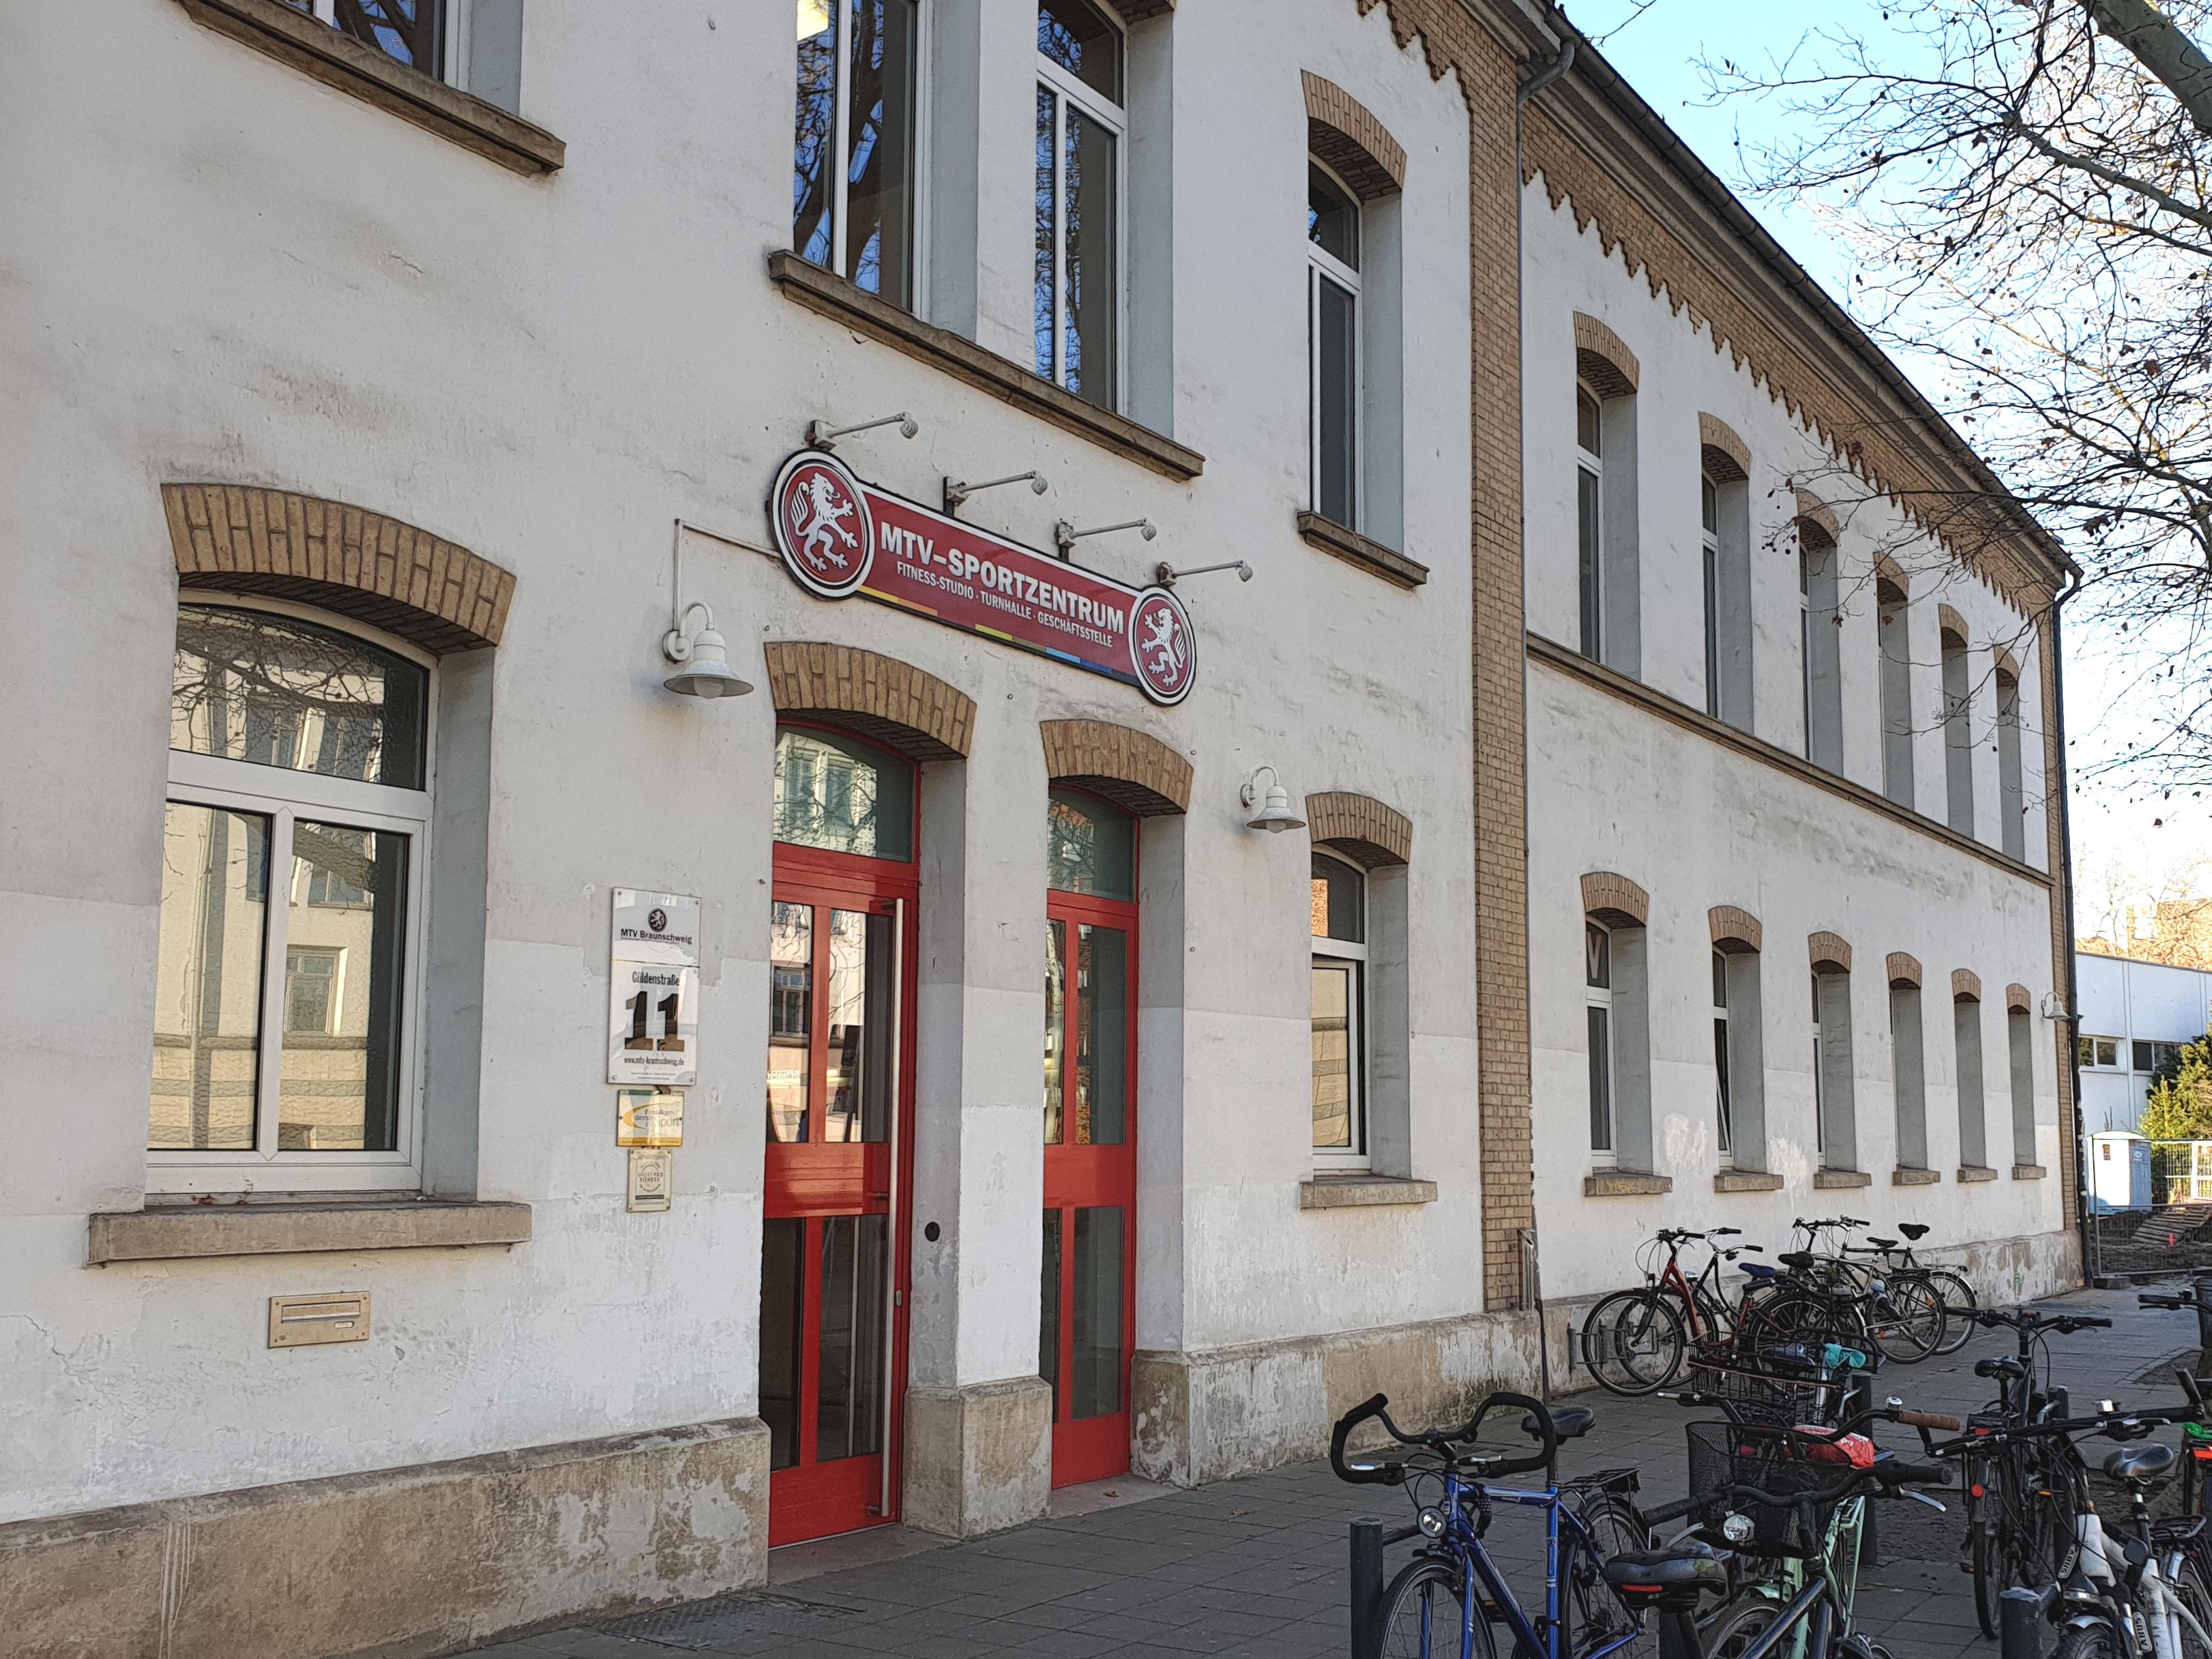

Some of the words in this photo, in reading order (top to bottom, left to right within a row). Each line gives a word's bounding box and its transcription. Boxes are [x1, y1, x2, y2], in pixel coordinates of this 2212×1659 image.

[881, 521, 1124, 634] MTV-SPORTZENTRUM
[980, 591, 1032, 620] TURNHALLE
[1037, 611, 1113, 647] GESCHÄFTSSTELLE
[621, 928, 638, 937] MTV
[640, 930, 692, 945] Braunschweig
[632, 971, 680, 986] Güldenstraße
[625, 991, 685, 1052] 11
[2136, 1617, 2149, 1646] ABUS
